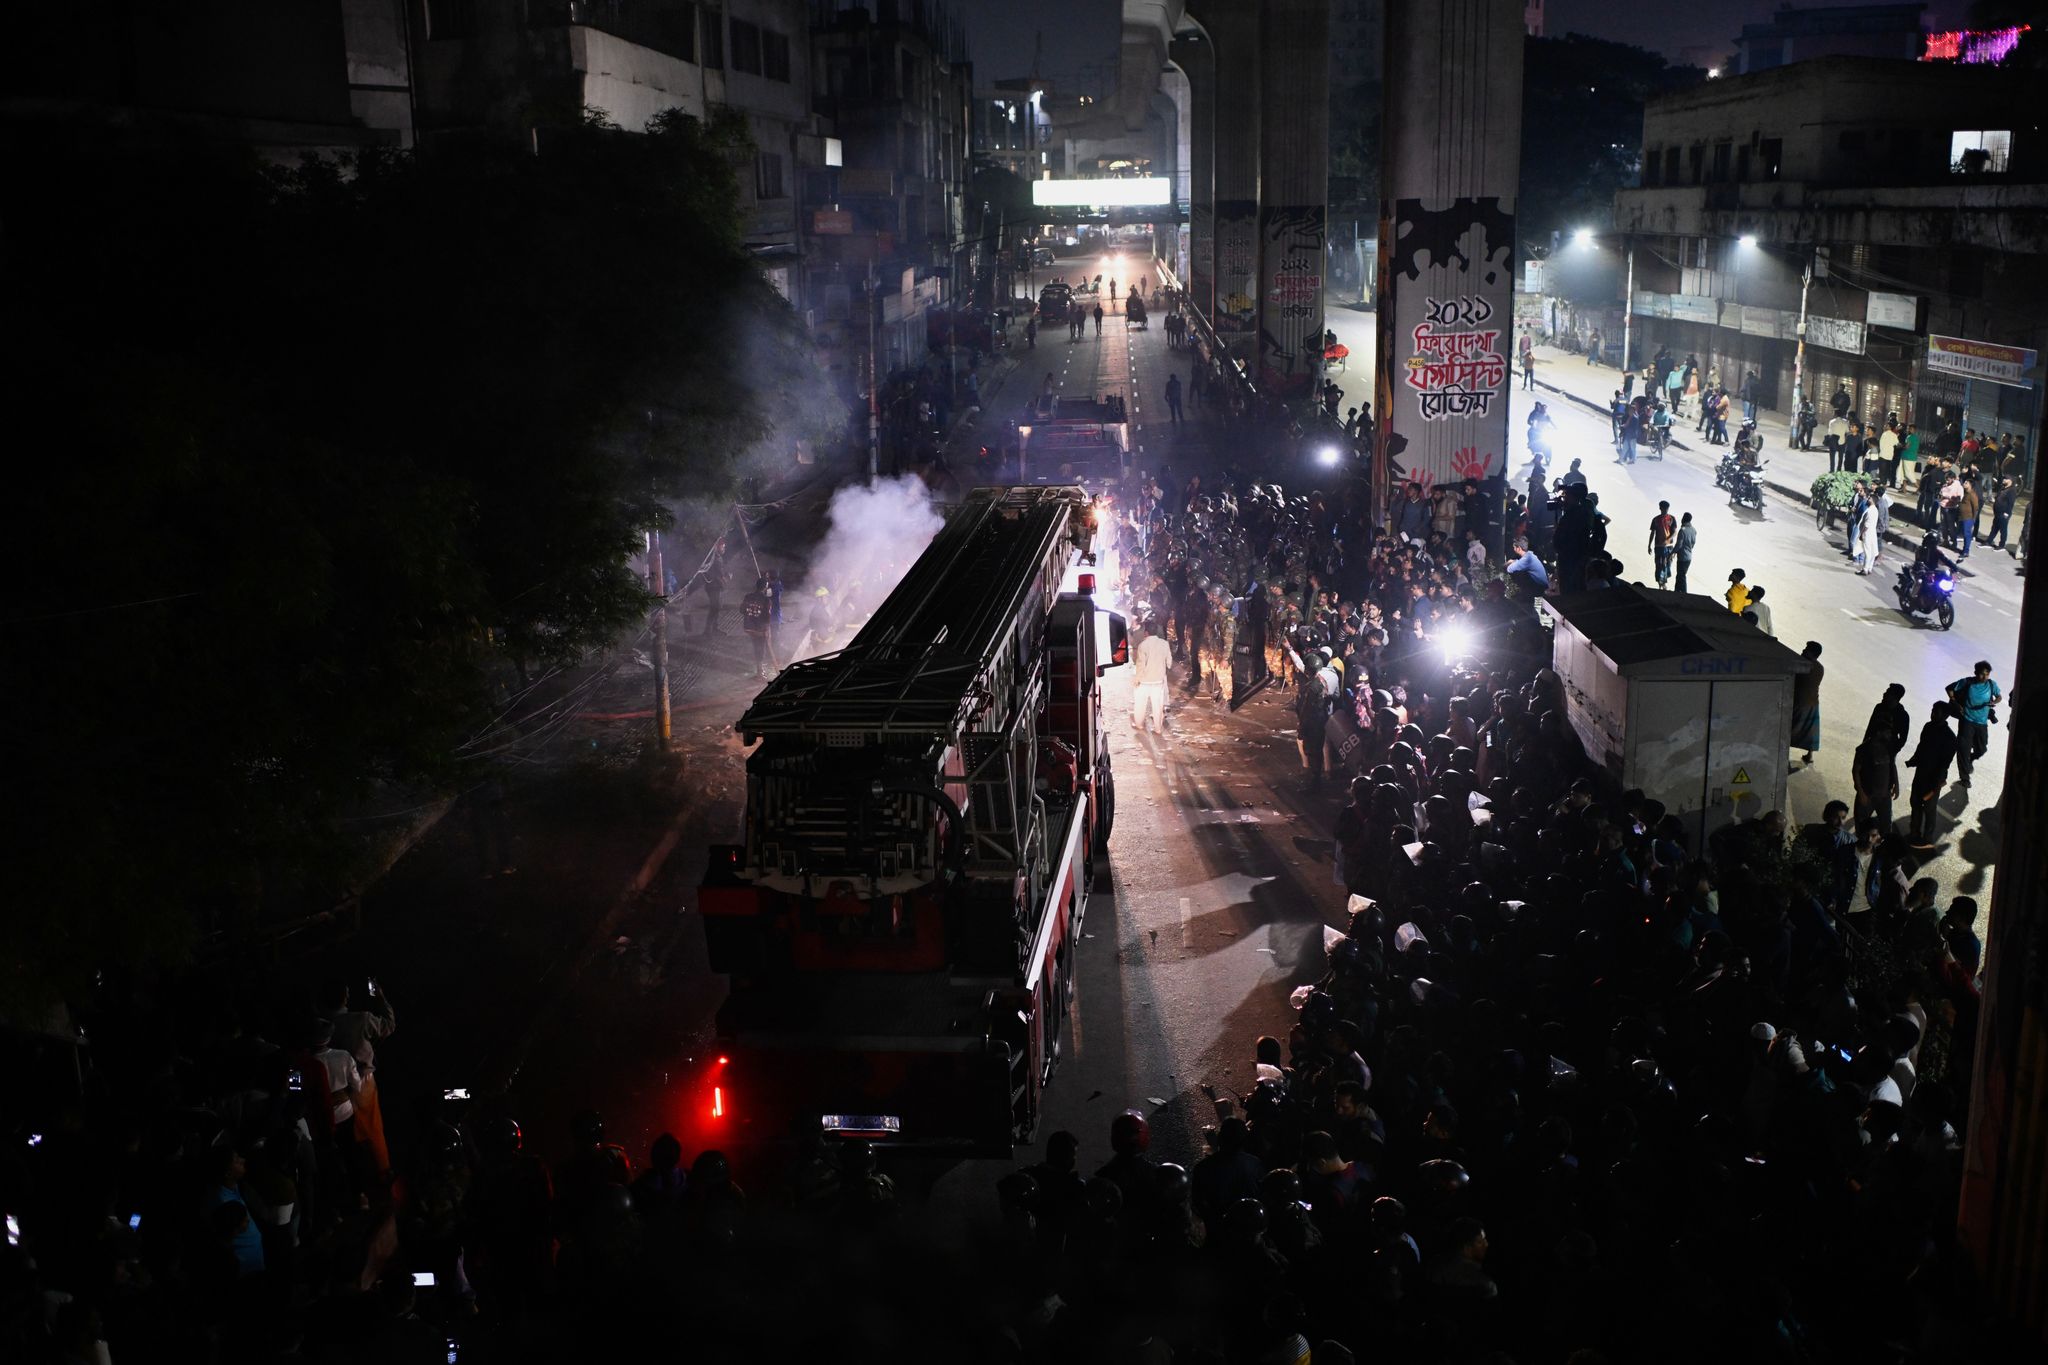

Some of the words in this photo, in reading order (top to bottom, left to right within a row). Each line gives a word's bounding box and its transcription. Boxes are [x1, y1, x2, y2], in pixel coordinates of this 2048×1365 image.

[1281, 258, 1310, 271] ২০২২
[1426, 296, 1492, 325] ২০২১
[1414, 323, 1456, 357] ফিরে
[1457, 331, 1497, 354] দেখা
[1419, 384, 1495, 418] রেজিম
[1681, 656, 1749, 674] CHNT
